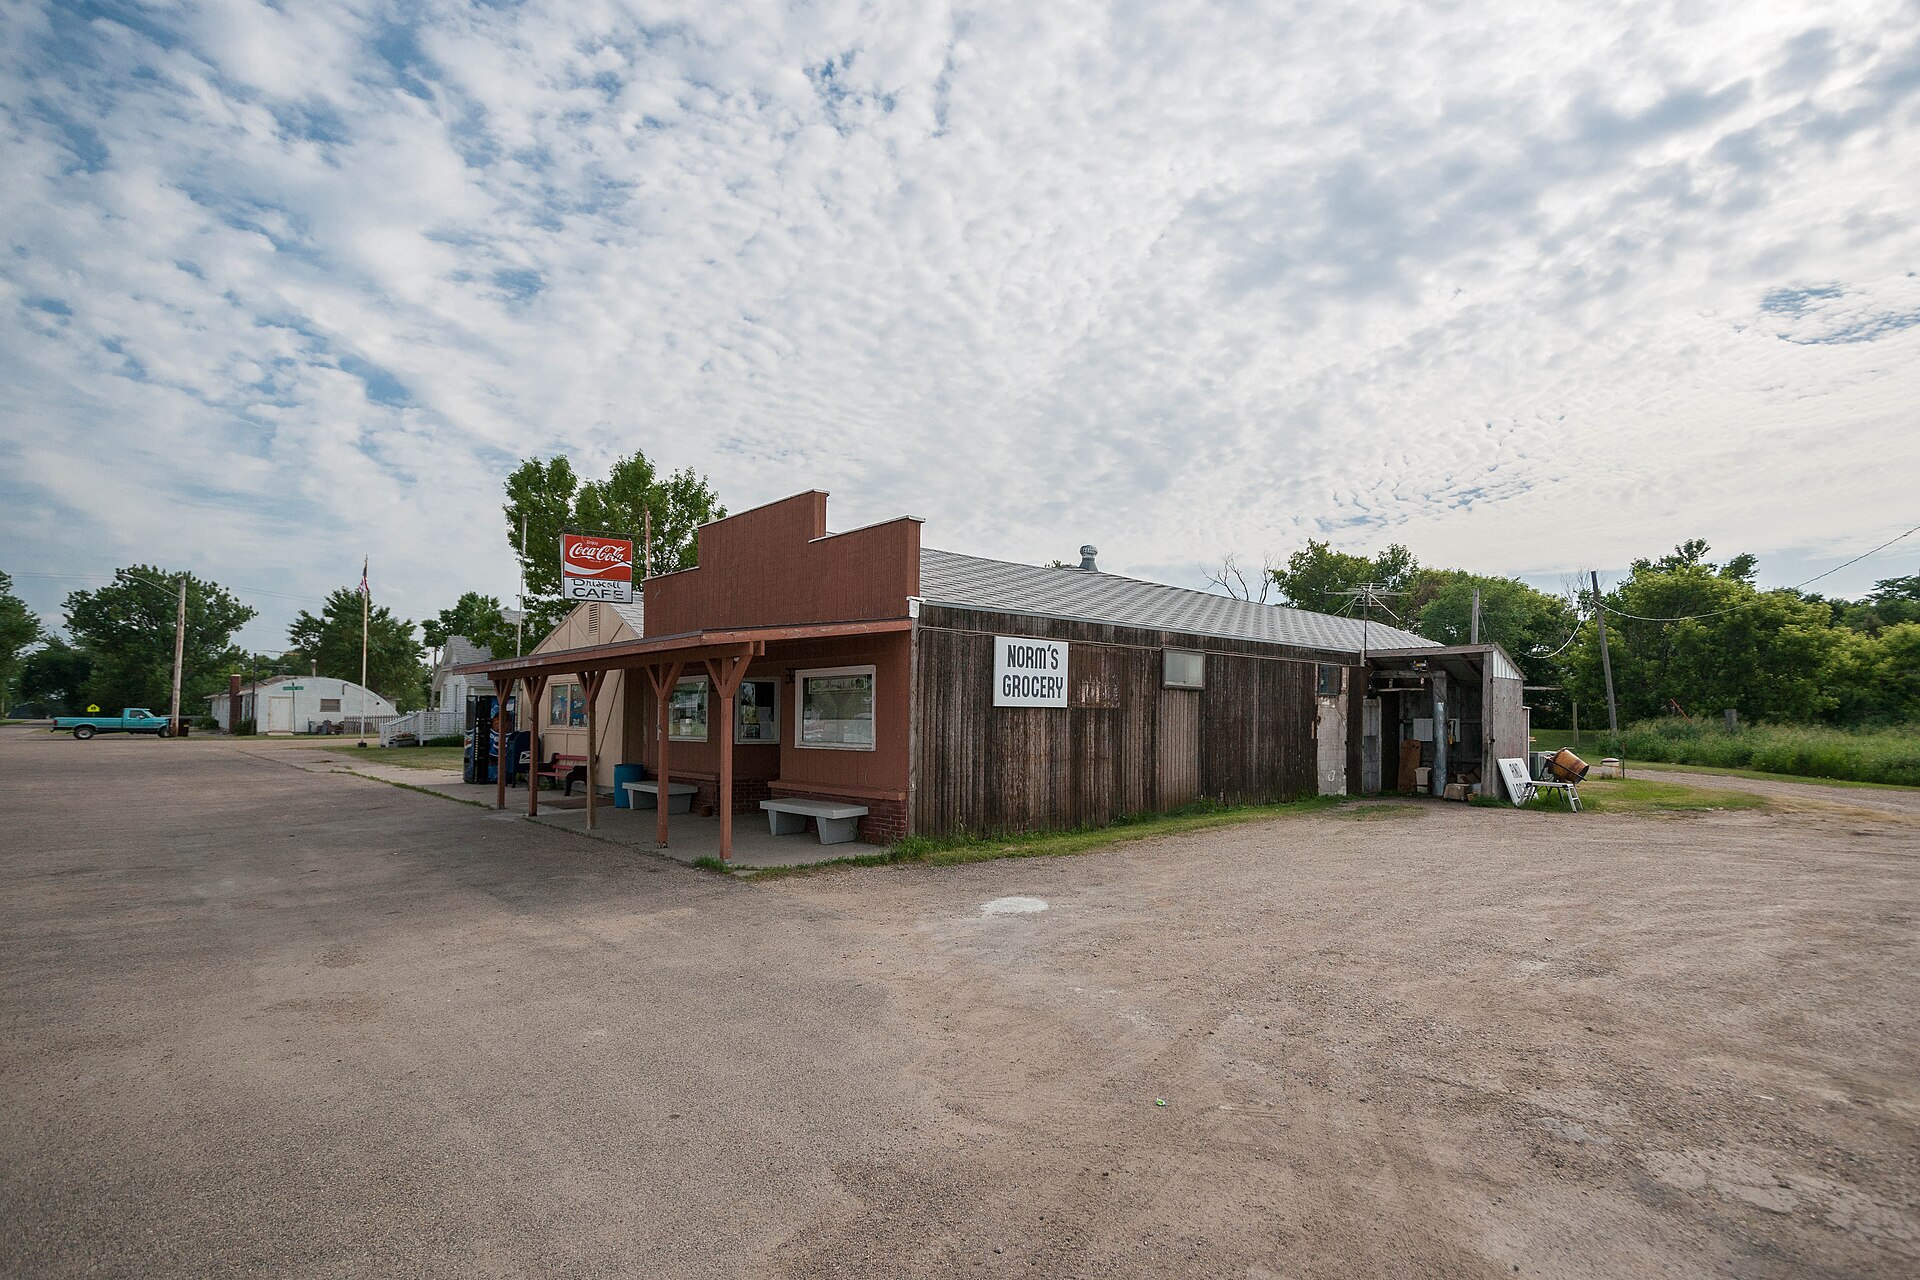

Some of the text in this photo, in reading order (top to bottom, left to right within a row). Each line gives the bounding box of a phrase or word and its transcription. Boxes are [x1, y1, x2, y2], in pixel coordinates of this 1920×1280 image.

[569, 542, 627, 562] Coca-Cola
[571, 578, 621, 589] Driscoll
[572, 587, 624, 600] CAFE
[1007, 644, 1059, 670] NORM'S
[1002, 674, 1063, 699] GROCERY
